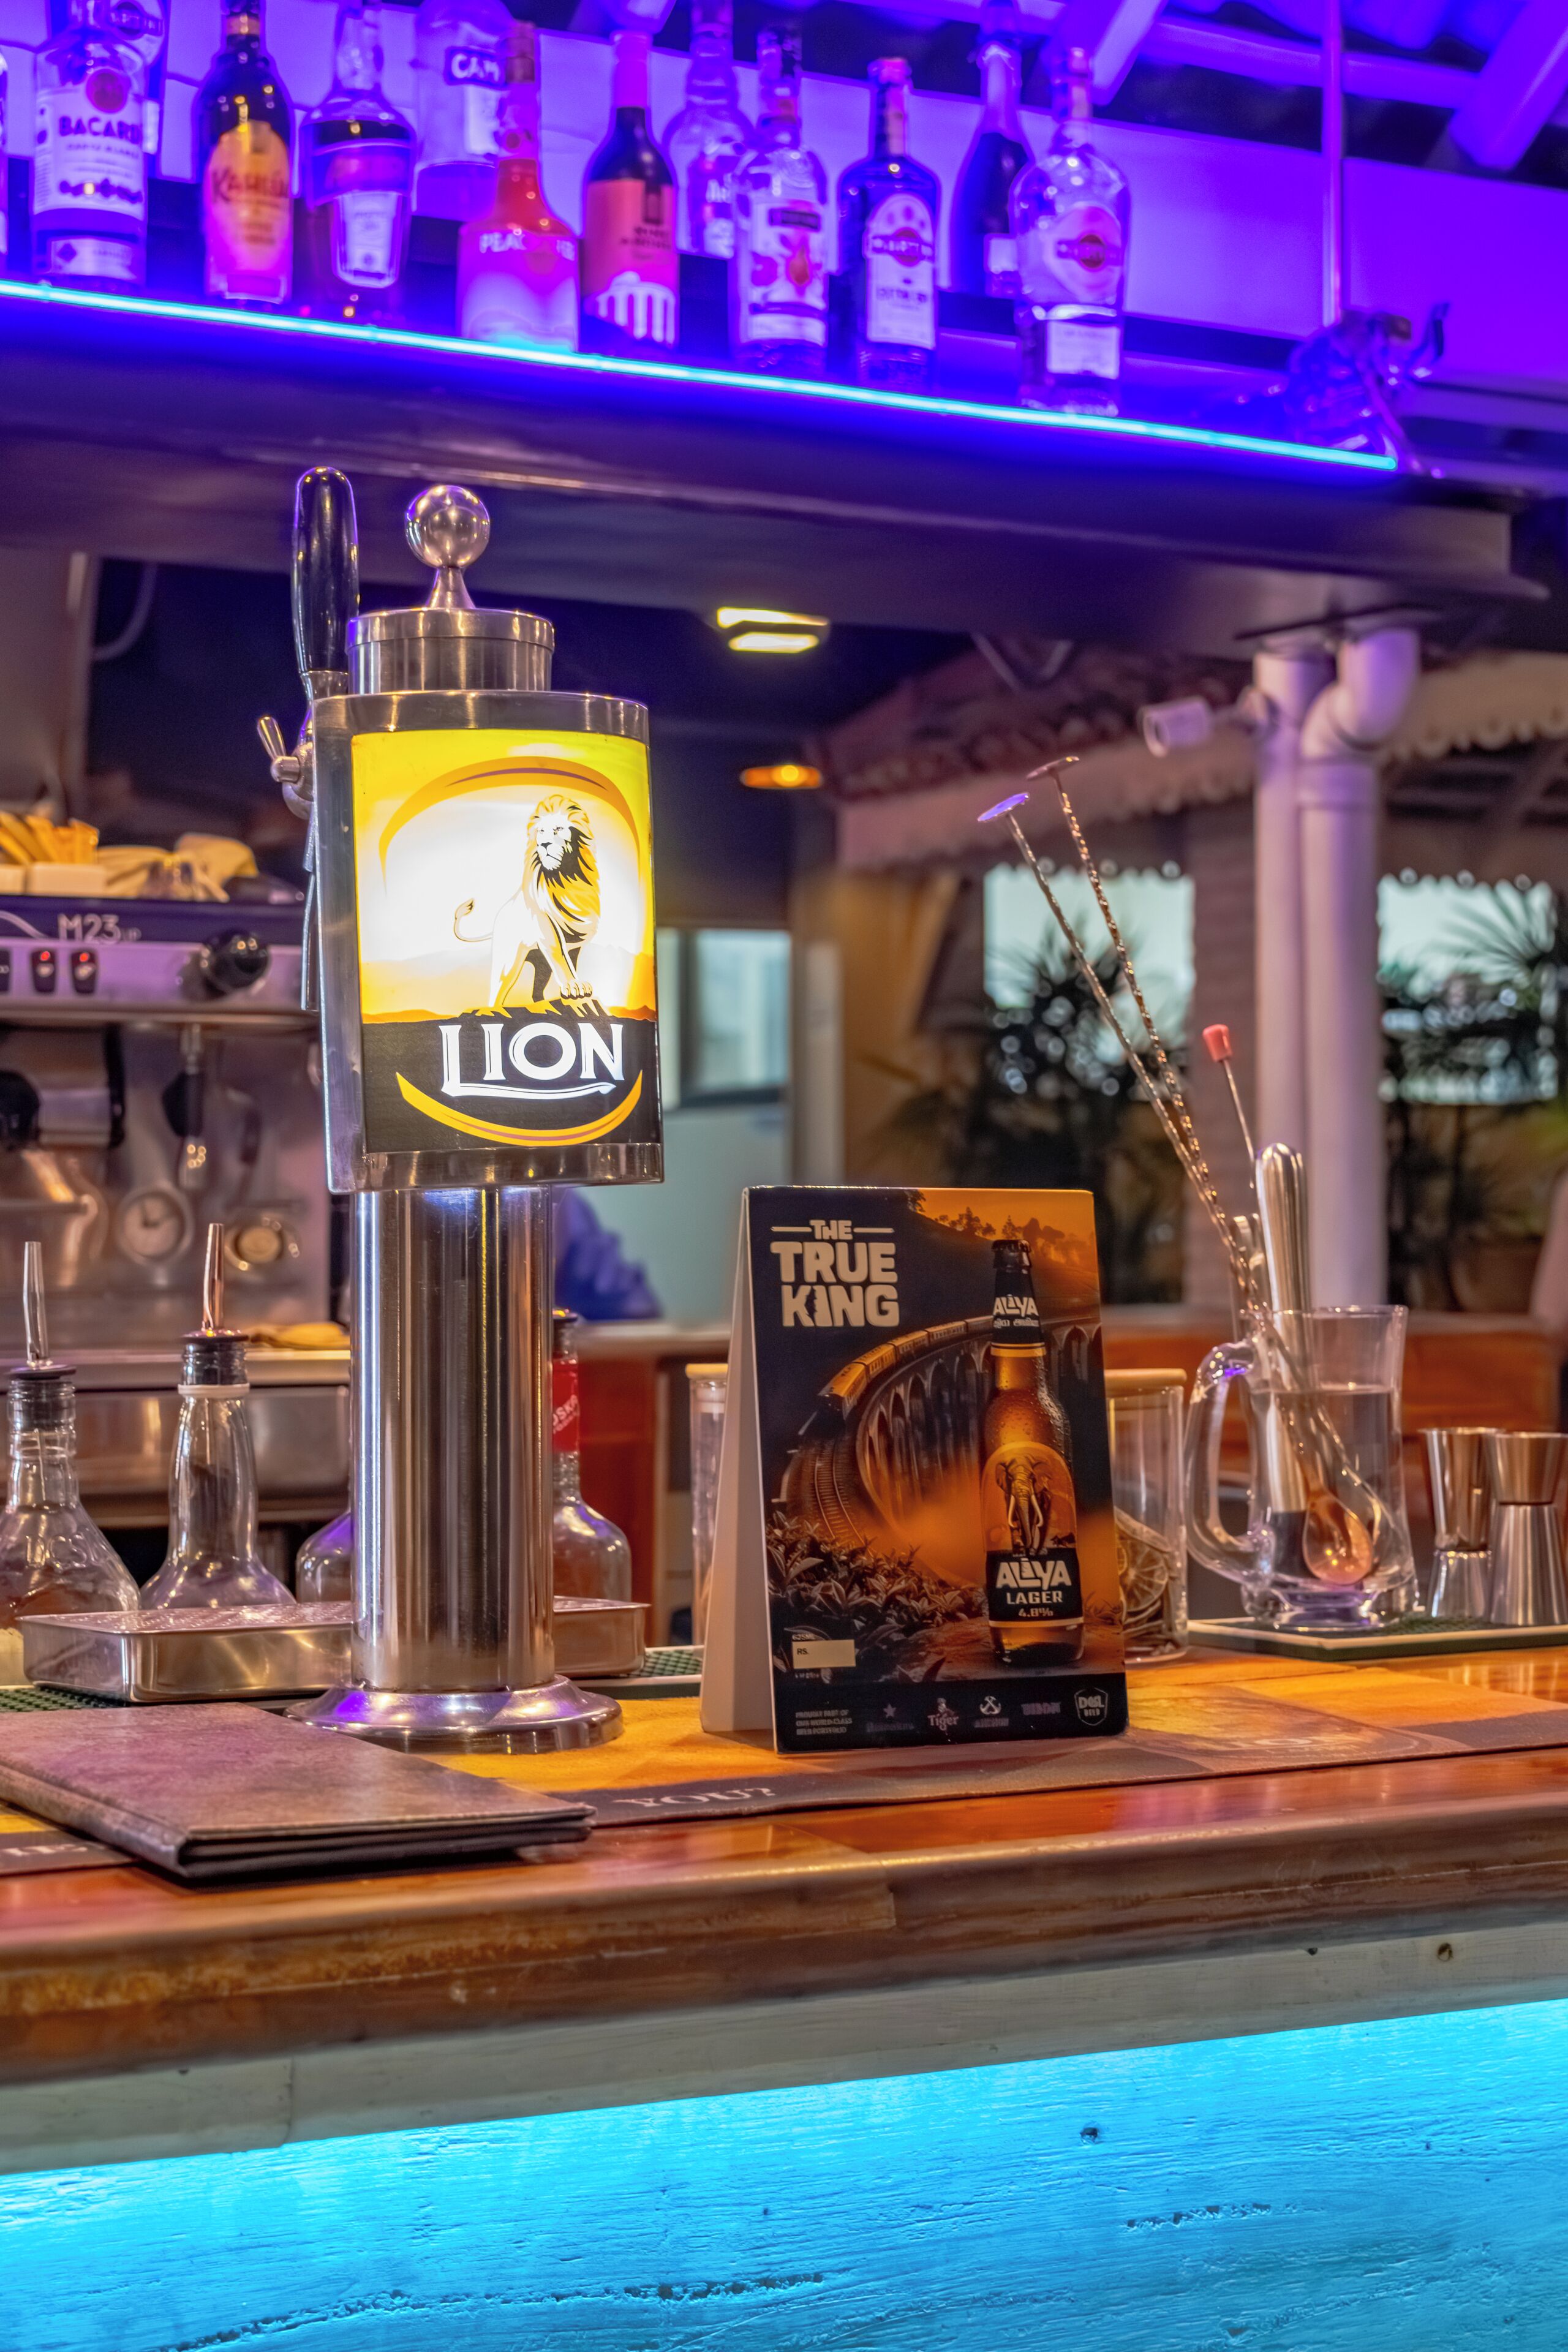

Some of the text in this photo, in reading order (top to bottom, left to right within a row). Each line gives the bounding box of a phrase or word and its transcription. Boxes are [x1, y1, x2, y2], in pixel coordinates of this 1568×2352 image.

[58, 913, 121, 944] M23
[439, 1022, 625, 1100] LION
[810, 1219, 853, 1240] THE
[770, 1241, 898, 1283] TRUE
[781, 1284, 900, 1327] KING
[1006, 1591, 1063, 1605] LAGER
[1018, 1607, 1054, 1618] 4.8%
[927, 1714, 959, 1732] Tiger
[611, 1787, 776, 1807] YOU?
